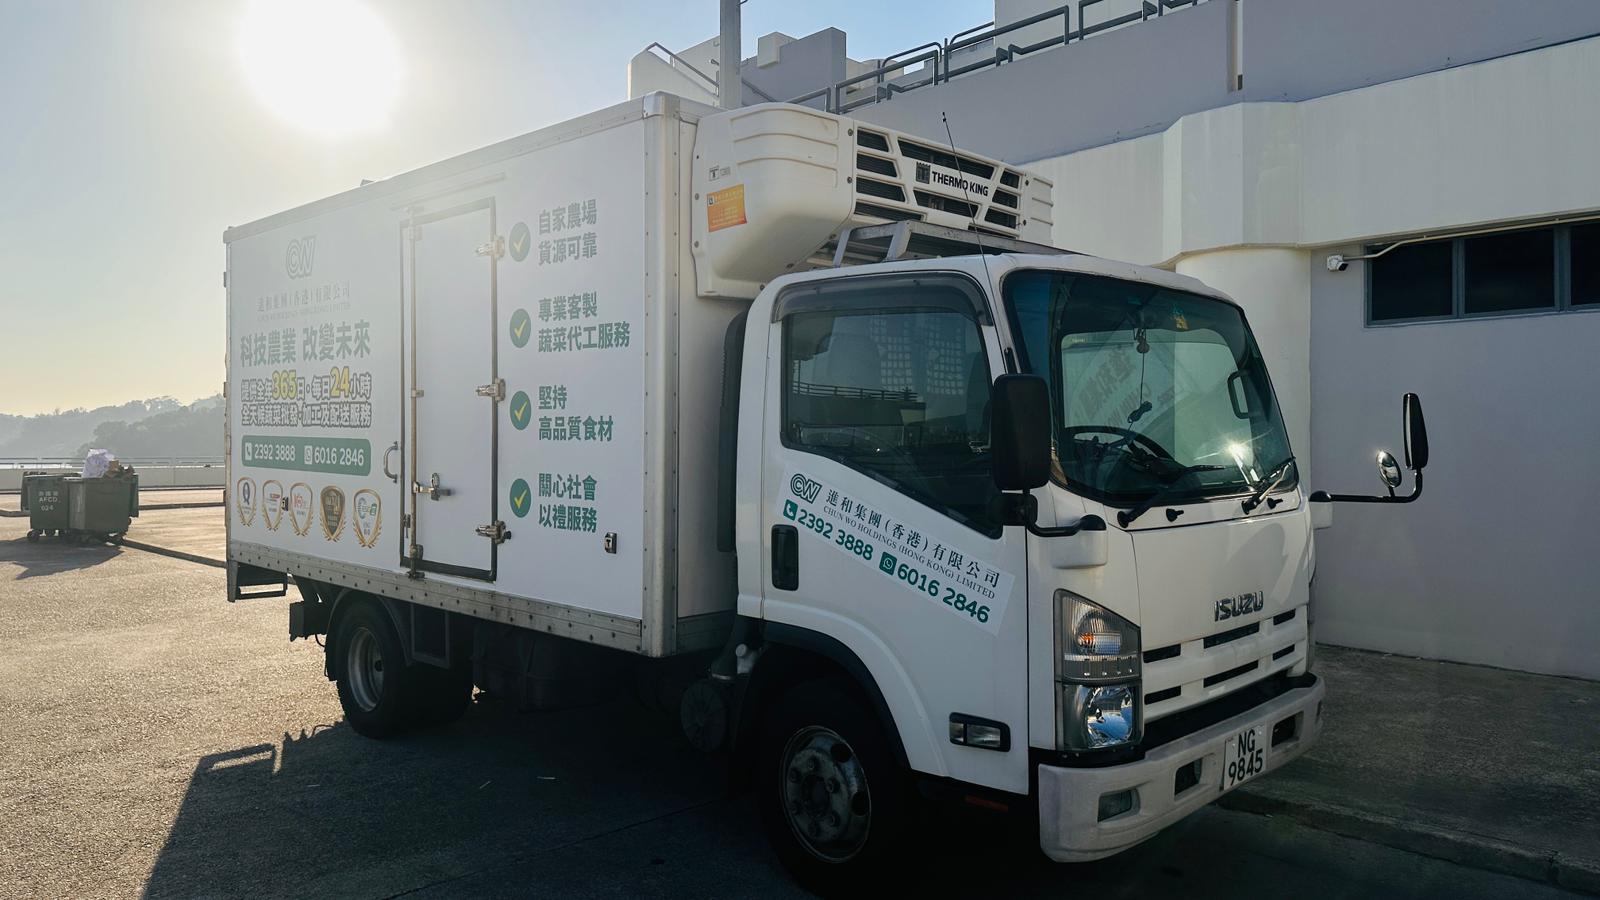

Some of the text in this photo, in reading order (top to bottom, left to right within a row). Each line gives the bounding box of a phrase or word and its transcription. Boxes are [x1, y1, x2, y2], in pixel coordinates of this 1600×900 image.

[932, 171, 989, 197] THERMO KING
[538, 199, 597, 235] 自家農場
[538, 231, 597, 266] 貨源可靠
[538, 291, 597, 322] 專業客製
[240, 319, 371, 367] 科技農業 改變未來
[538, 321, 630, 353] 蔬菜代工服務
[538, 385, 567, 410] 堅持
[538, 415, 614, 442] 高品質食材
[254, 443, 296, 461] 2392 3888
[314, 447, 364, 467] 6016 2846
[538, 473, 597, 501] 關心社會
[538, 504, 597, 534] 以禮服務
[797, 508, 990, 623] 2392 3888 6016 2846
[823, 505, 995, 600] CHUN WO HOLDINGS (HONG KONG) LIMITED
[1213, 590, 1264, 622] ISUZU
[1238, 729, 1255, 758] NG
[1228, 748, 1263, 786] 9845
